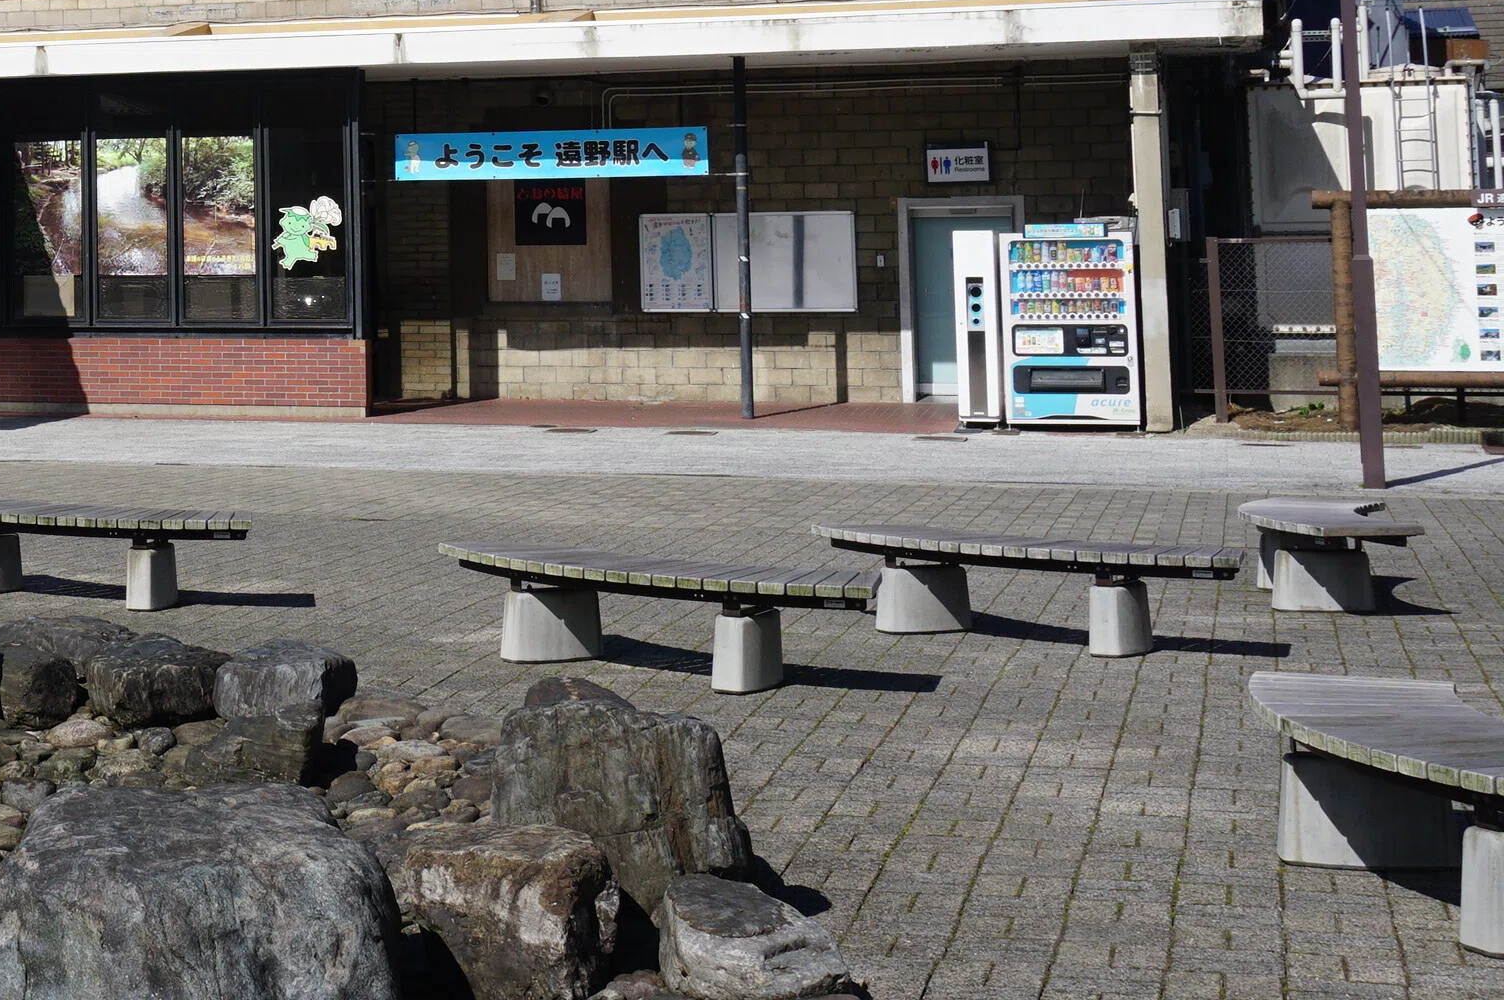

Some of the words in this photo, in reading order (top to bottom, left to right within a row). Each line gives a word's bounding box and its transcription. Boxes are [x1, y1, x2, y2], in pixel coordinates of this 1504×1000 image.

[433, 141, 542, 170] ようこそ
[555, 137, 670, 167] 遠野駅へ
[954, 155, 984, 165] 化粧室
[1477, 193, 1494, 204] JR
[1090, 398, 1132, 407] acure
